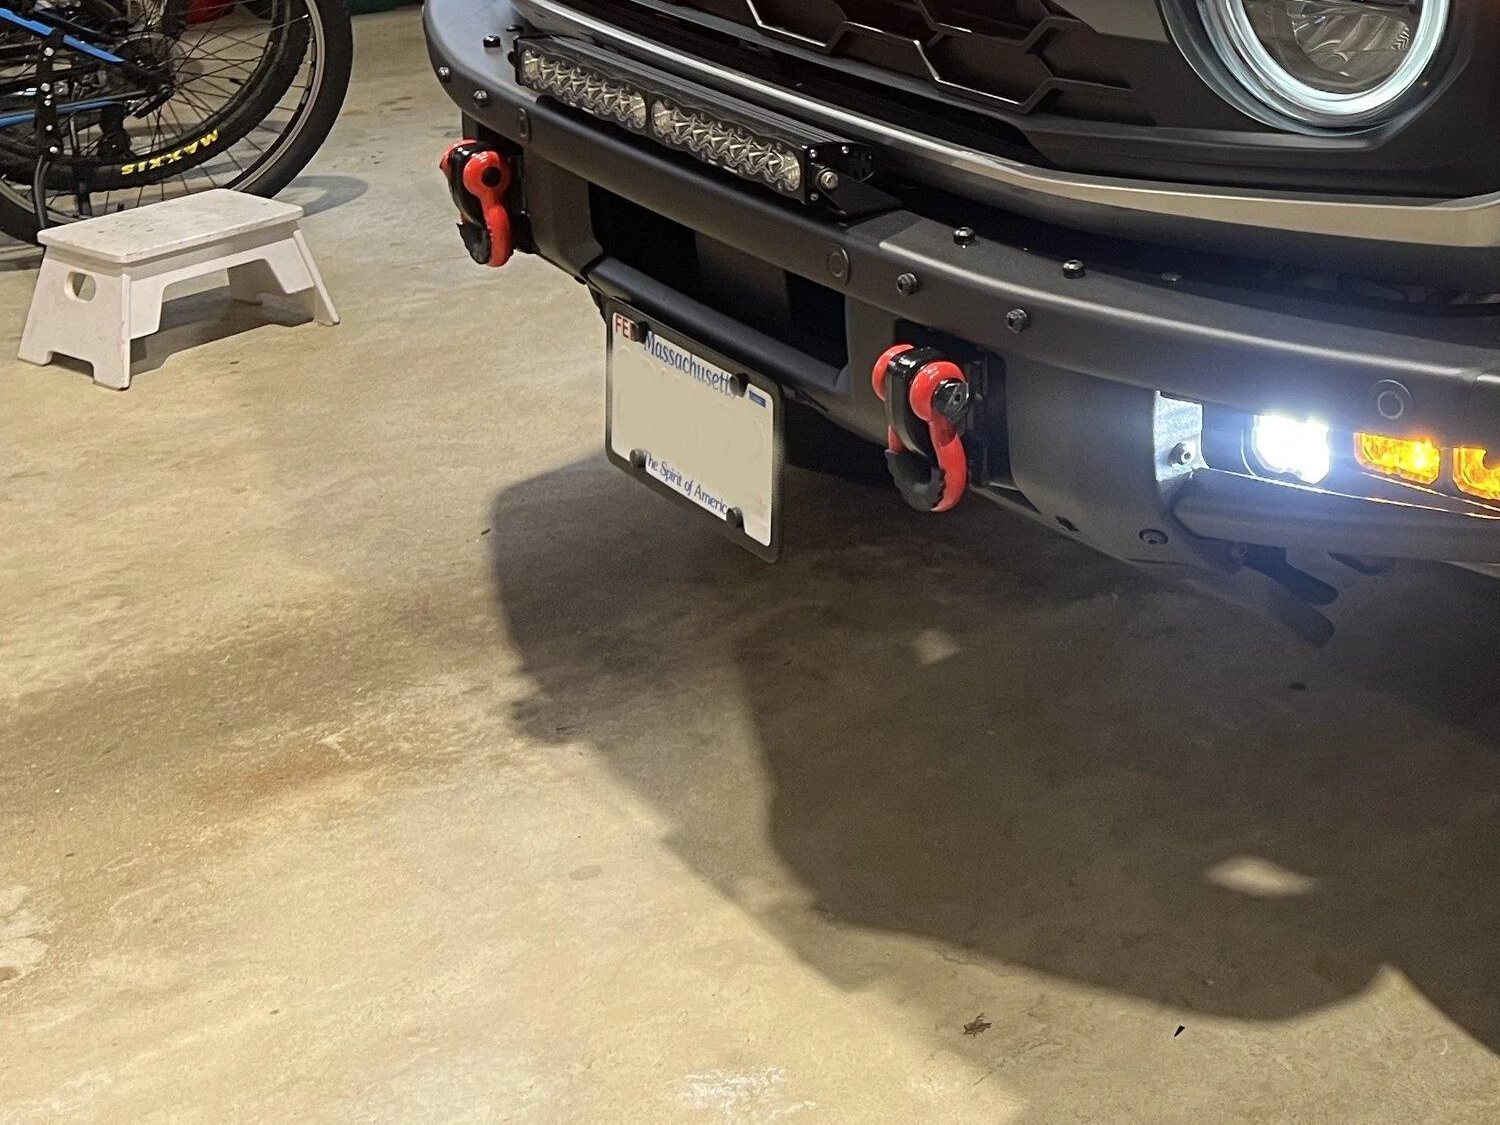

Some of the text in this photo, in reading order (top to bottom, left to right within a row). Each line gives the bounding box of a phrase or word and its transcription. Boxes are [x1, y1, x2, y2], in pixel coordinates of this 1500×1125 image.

[121, 128, 219, 176] MAXXIS
[660, 461, 682, 487] Spirit
[684, 479, 694, 496] of
[694, 483, 728, 515] Americ
